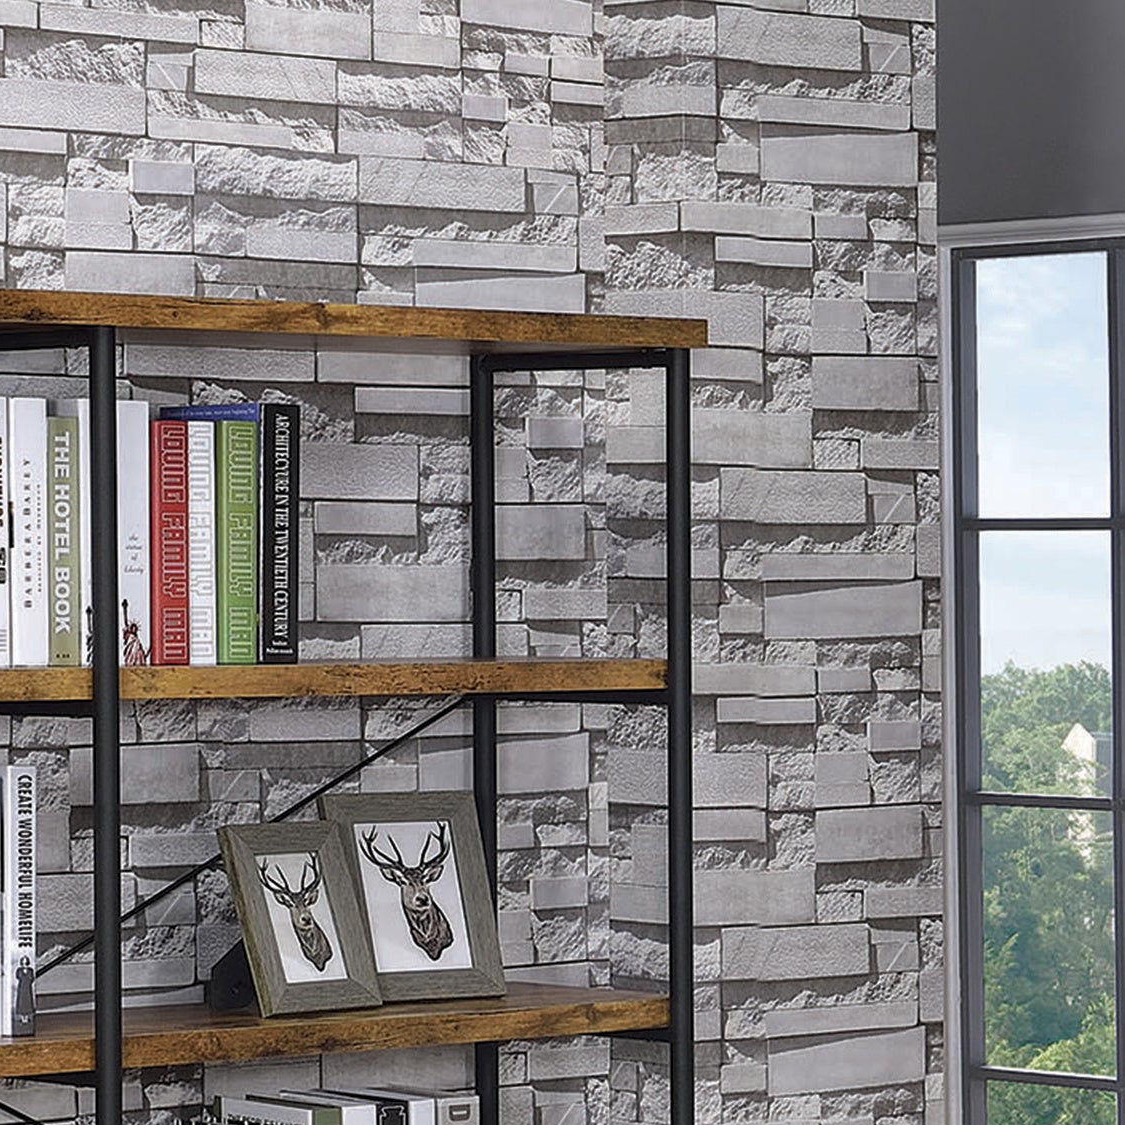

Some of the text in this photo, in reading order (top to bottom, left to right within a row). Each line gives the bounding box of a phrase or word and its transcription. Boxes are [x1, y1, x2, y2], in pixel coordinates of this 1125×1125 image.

[54, 431, 71, 478] THE
[54, 485, 71, 560] HOTEL
[275, 494, 290, 506] IN
[275, 508, 290, 528] THE
[274, 529, 290, 589] TWENTIETH
[54, 567, 72, 634] BOOK
[273, 590, 289, 639] CENTURY
[17, 774, 33, 948] CREATE WONDERFUL HOMELIFE
